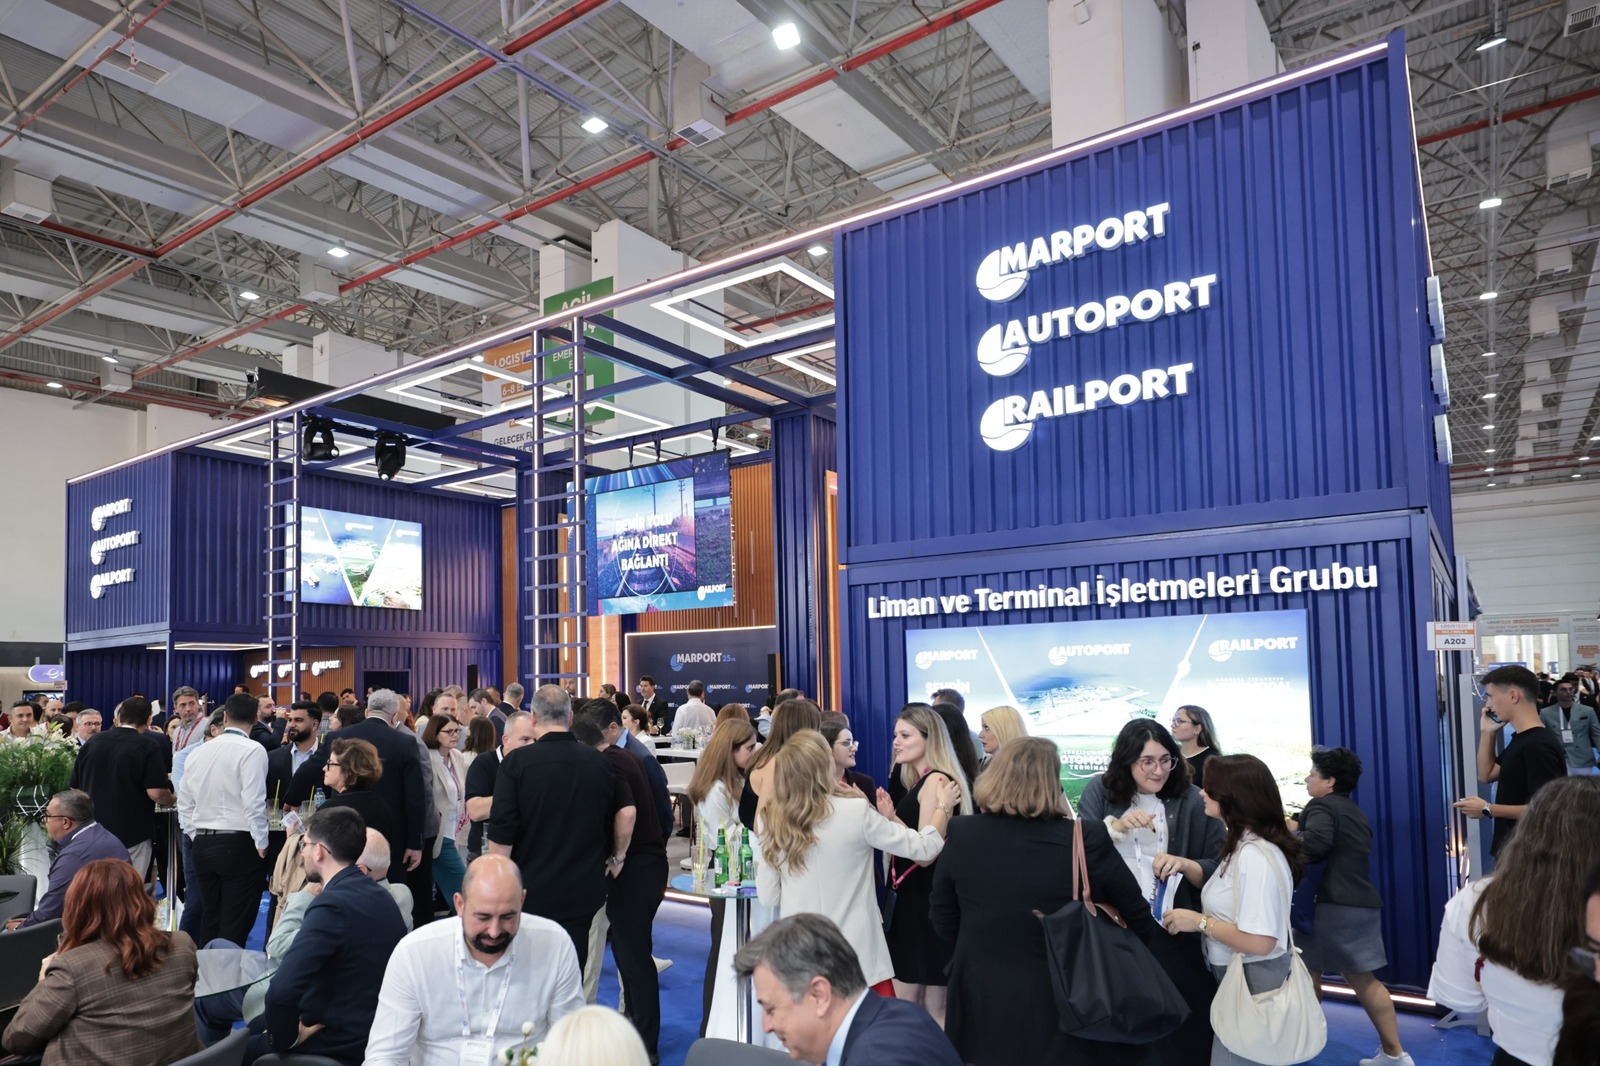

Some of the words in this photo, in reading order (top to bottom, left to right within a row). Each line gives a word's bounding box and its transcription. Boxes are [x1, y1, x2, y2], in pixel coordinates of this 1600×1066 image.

[1000, 202, 1170, 276] MARPORT
[1002, 273, 1217, 350] AUTOPORT
[1004, 362, 1195, 426] RAILPORT
[611, 536, 641, 553] AĞINA
[642, 531, 679, 549] DİREKT
[621, 553, 669, 571] BAĞLANTI
[868, 596, 938, 619] Liman
[939, 594, 972, 614] ve
[973, 580, 1090, 612] Terminal
[1096, 569, 1261, 608] İşletmeleri
[1269, 562, 1379, 594] Grubu
[1058, 643, 1131, 658] AUTOPORT
[1219, 636, 1298, 652] RAILPORT
[676, 652, 722, 663] MARPORT
[1060, 754, 1111, 765] OTOMOT
